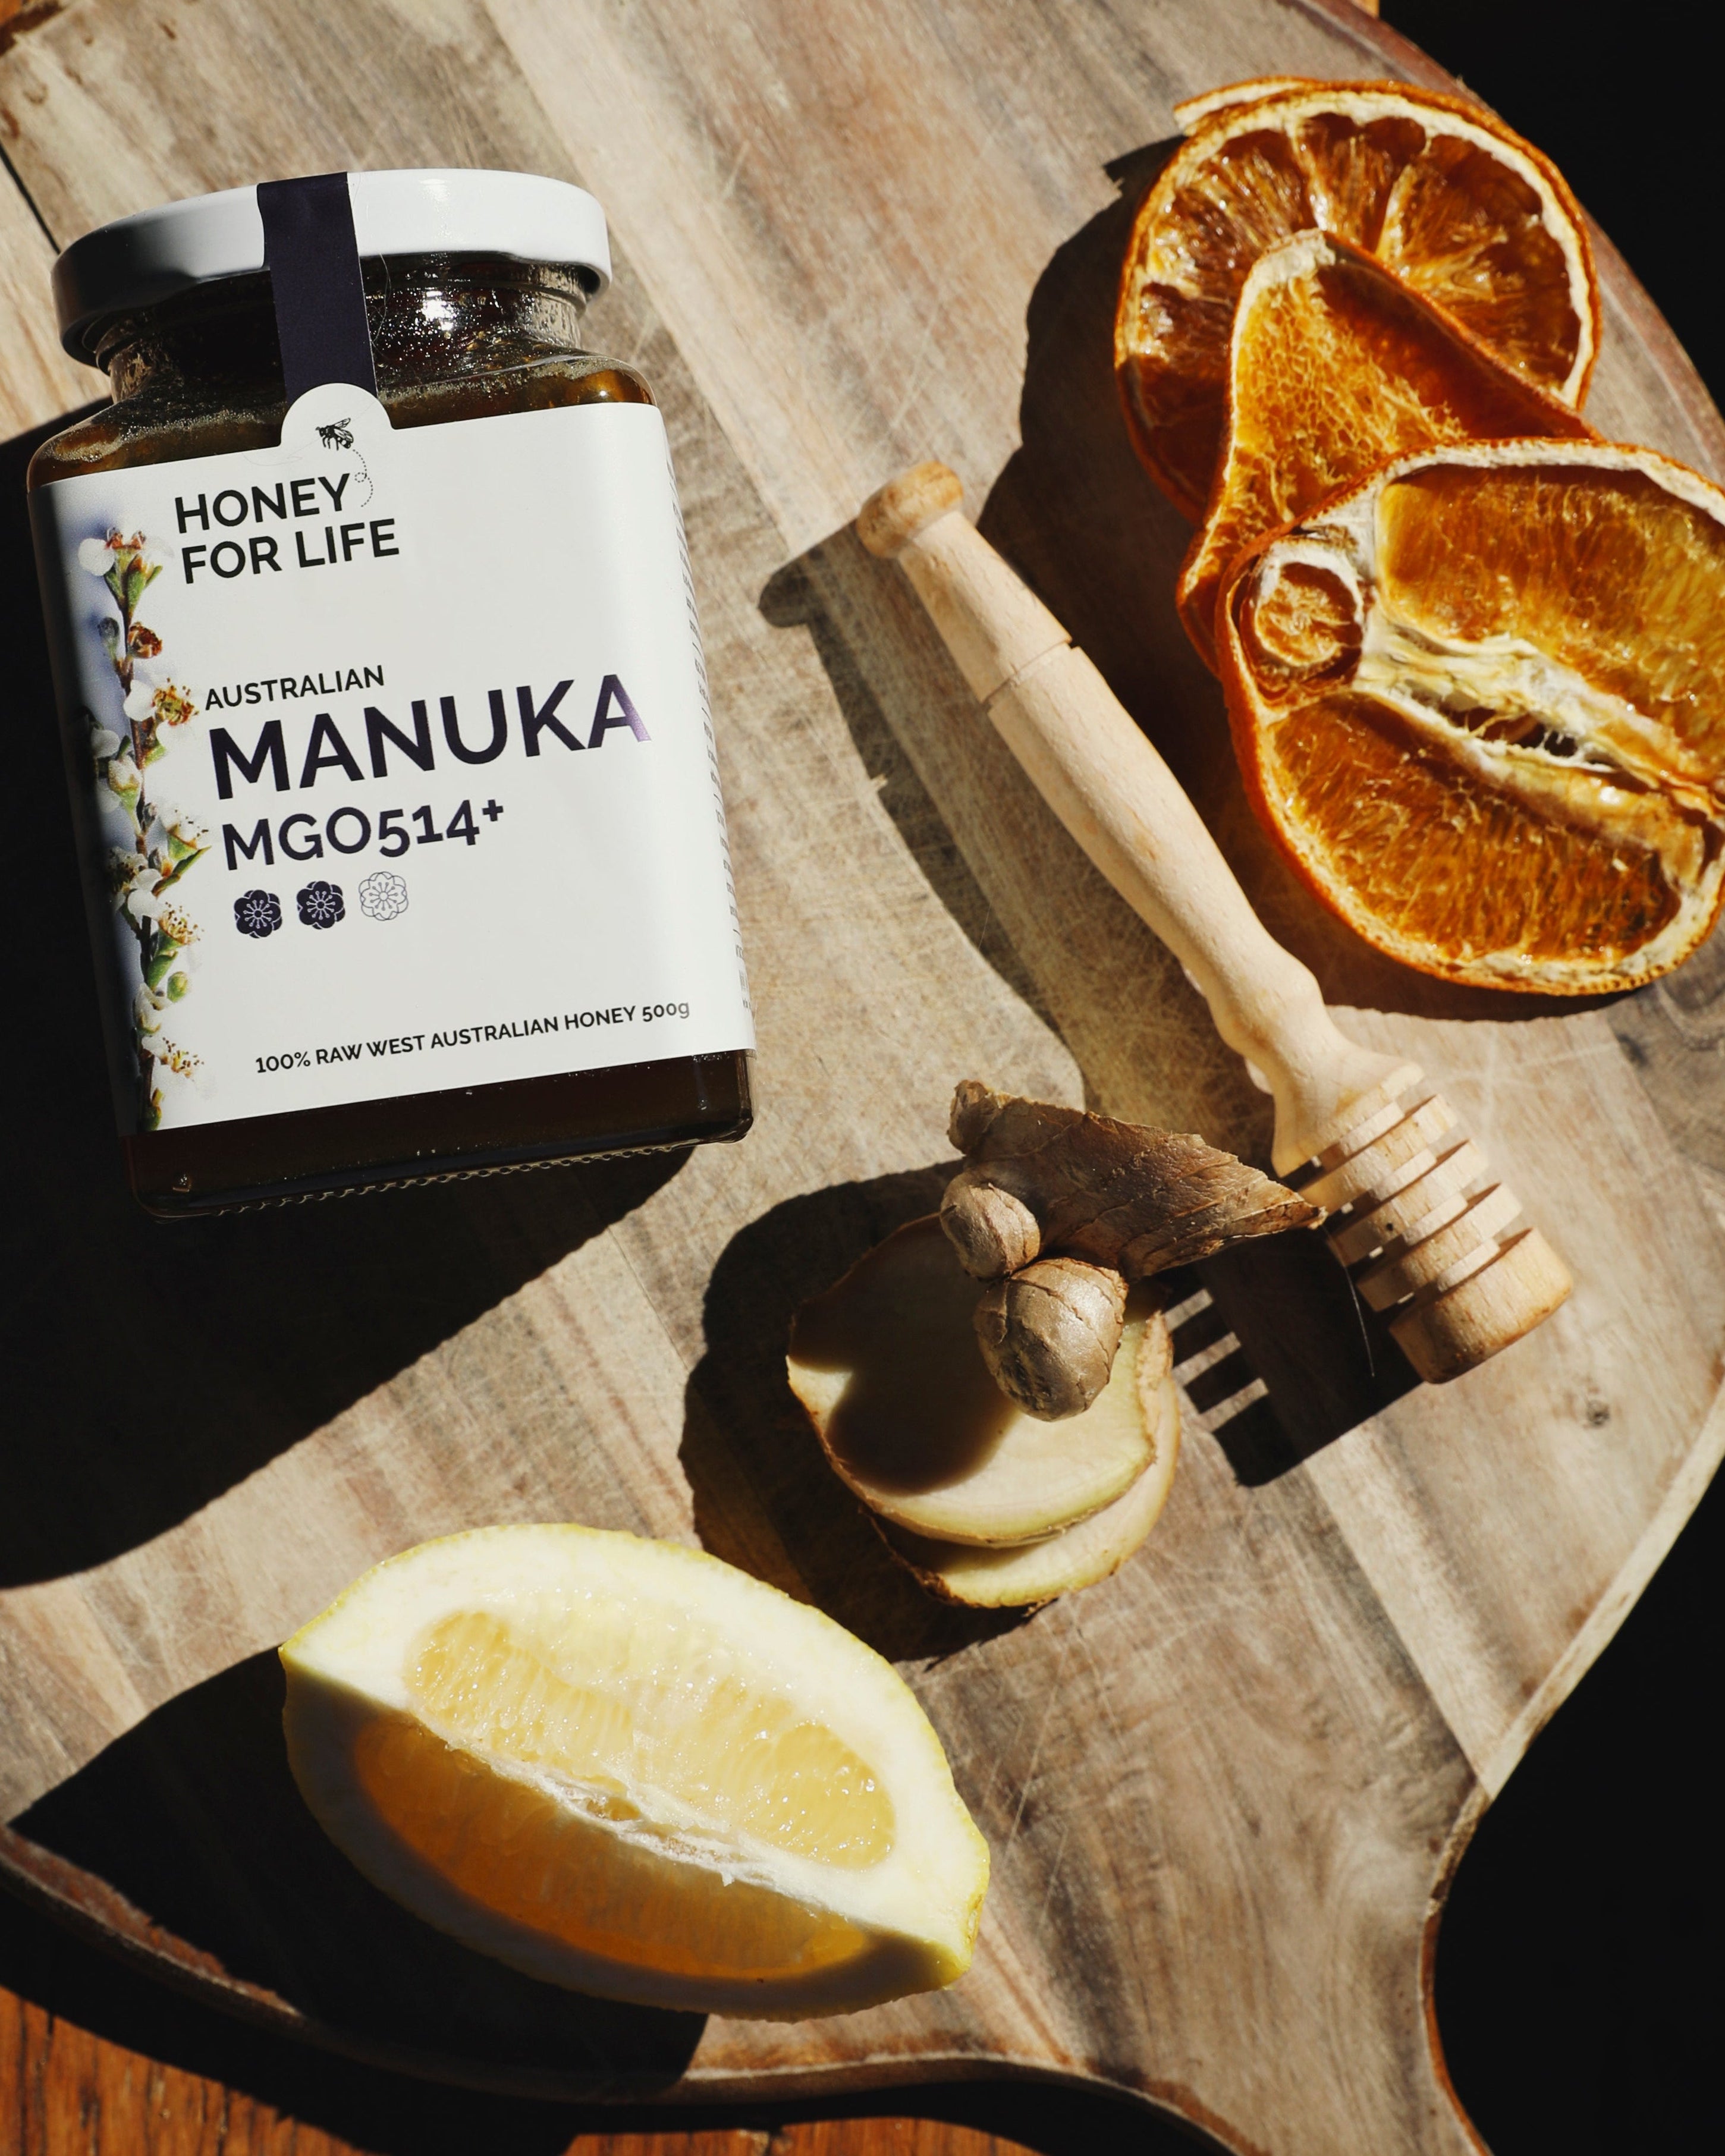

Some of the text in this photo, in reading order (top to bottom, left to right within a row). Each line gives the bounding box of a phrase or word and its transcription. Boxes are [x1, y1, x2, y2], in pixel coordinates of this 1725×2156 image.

[174, 473, 351, 534] HONEY
[181, 518, 400, 584] FOR LIFE
[205, 664, 385, 711] AUSTRALIAN
[208, 673, 652, 800] MANUKA
[222, 799, 505, 871] MGO514+
[255, 1001, 691, 1074] 100% RAW WEST AUSTRALIAN HONEY 500g
